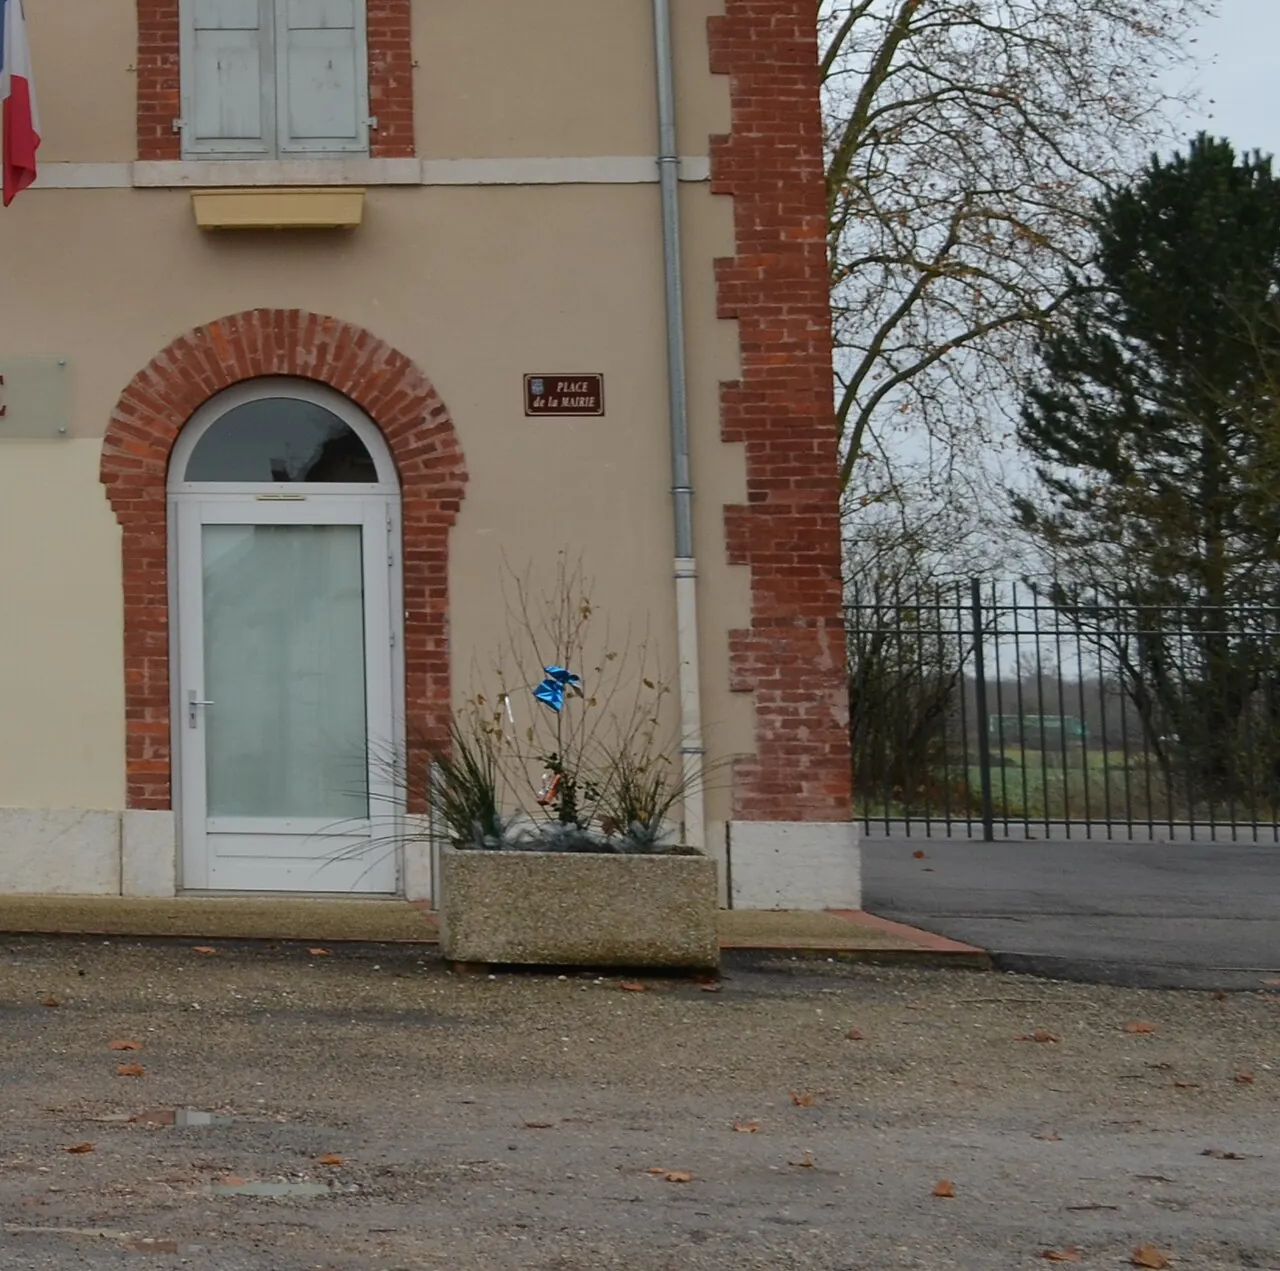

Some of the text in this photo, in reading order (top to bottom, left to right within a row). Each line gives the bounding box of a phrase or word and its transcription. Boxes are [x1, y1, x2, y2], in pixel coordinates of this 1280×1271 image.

[556, 381, 589, 393] PLACE
[533, 396, 596, 408] de la MAIRIE
